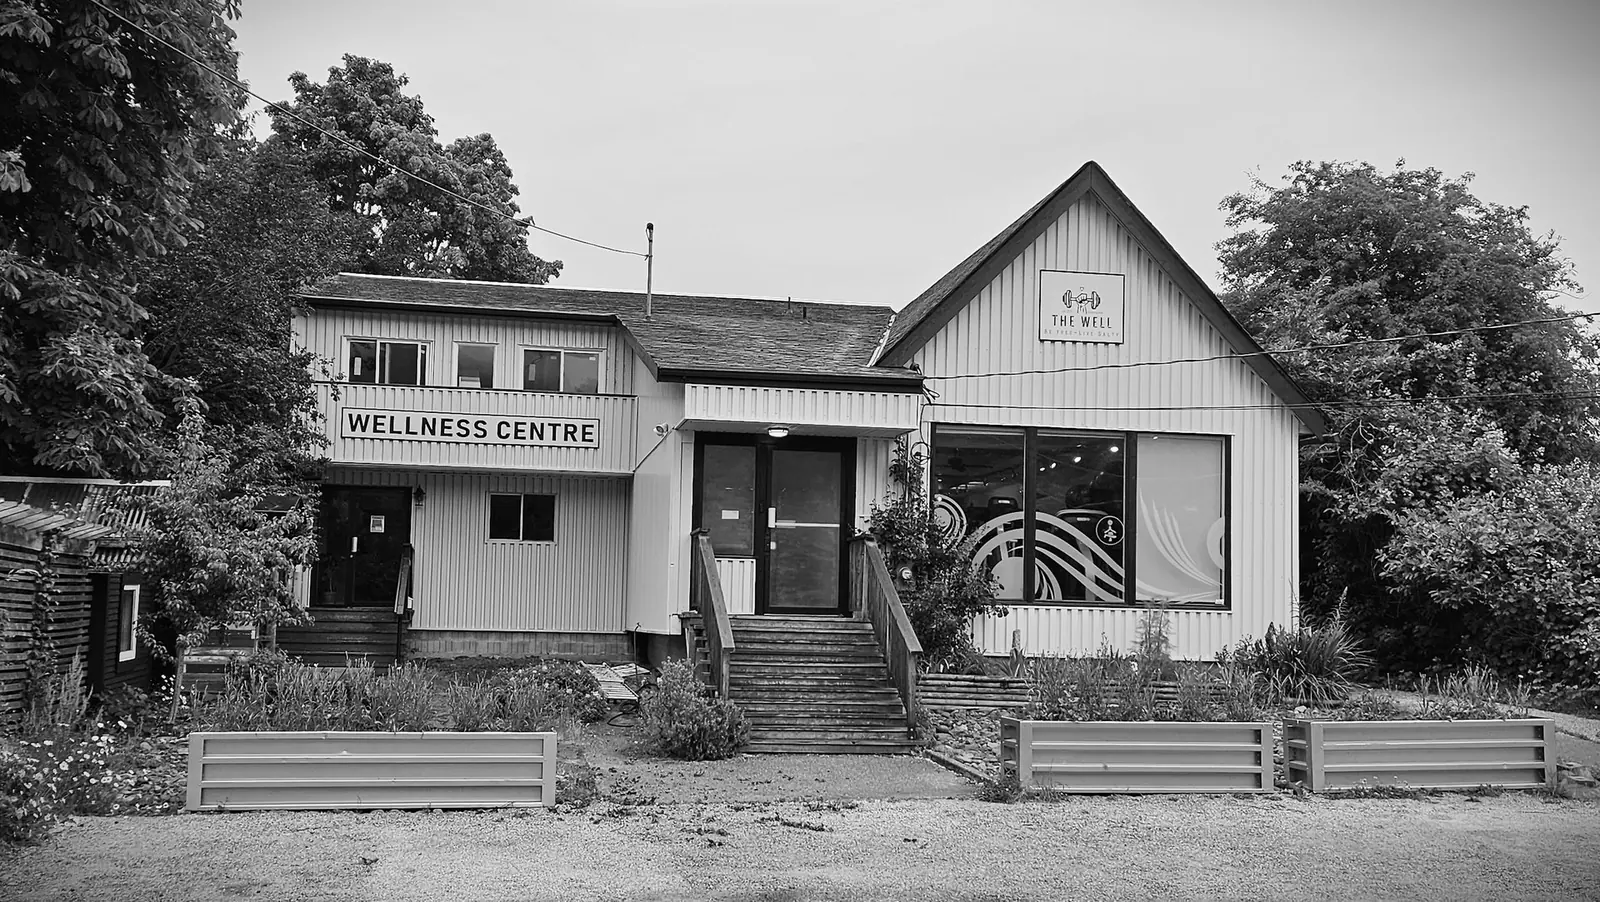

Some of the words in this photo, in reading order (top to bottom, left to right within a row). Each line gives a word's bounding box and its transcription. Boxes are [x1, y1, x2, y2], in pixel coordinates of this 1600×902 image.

[1052, 314, 1075, 327] THE
[1081, 316, 1112, 329] WELL
[348, 413, 488, 439] WELLNESS
[496, 420, 595, 443] CENTRE
